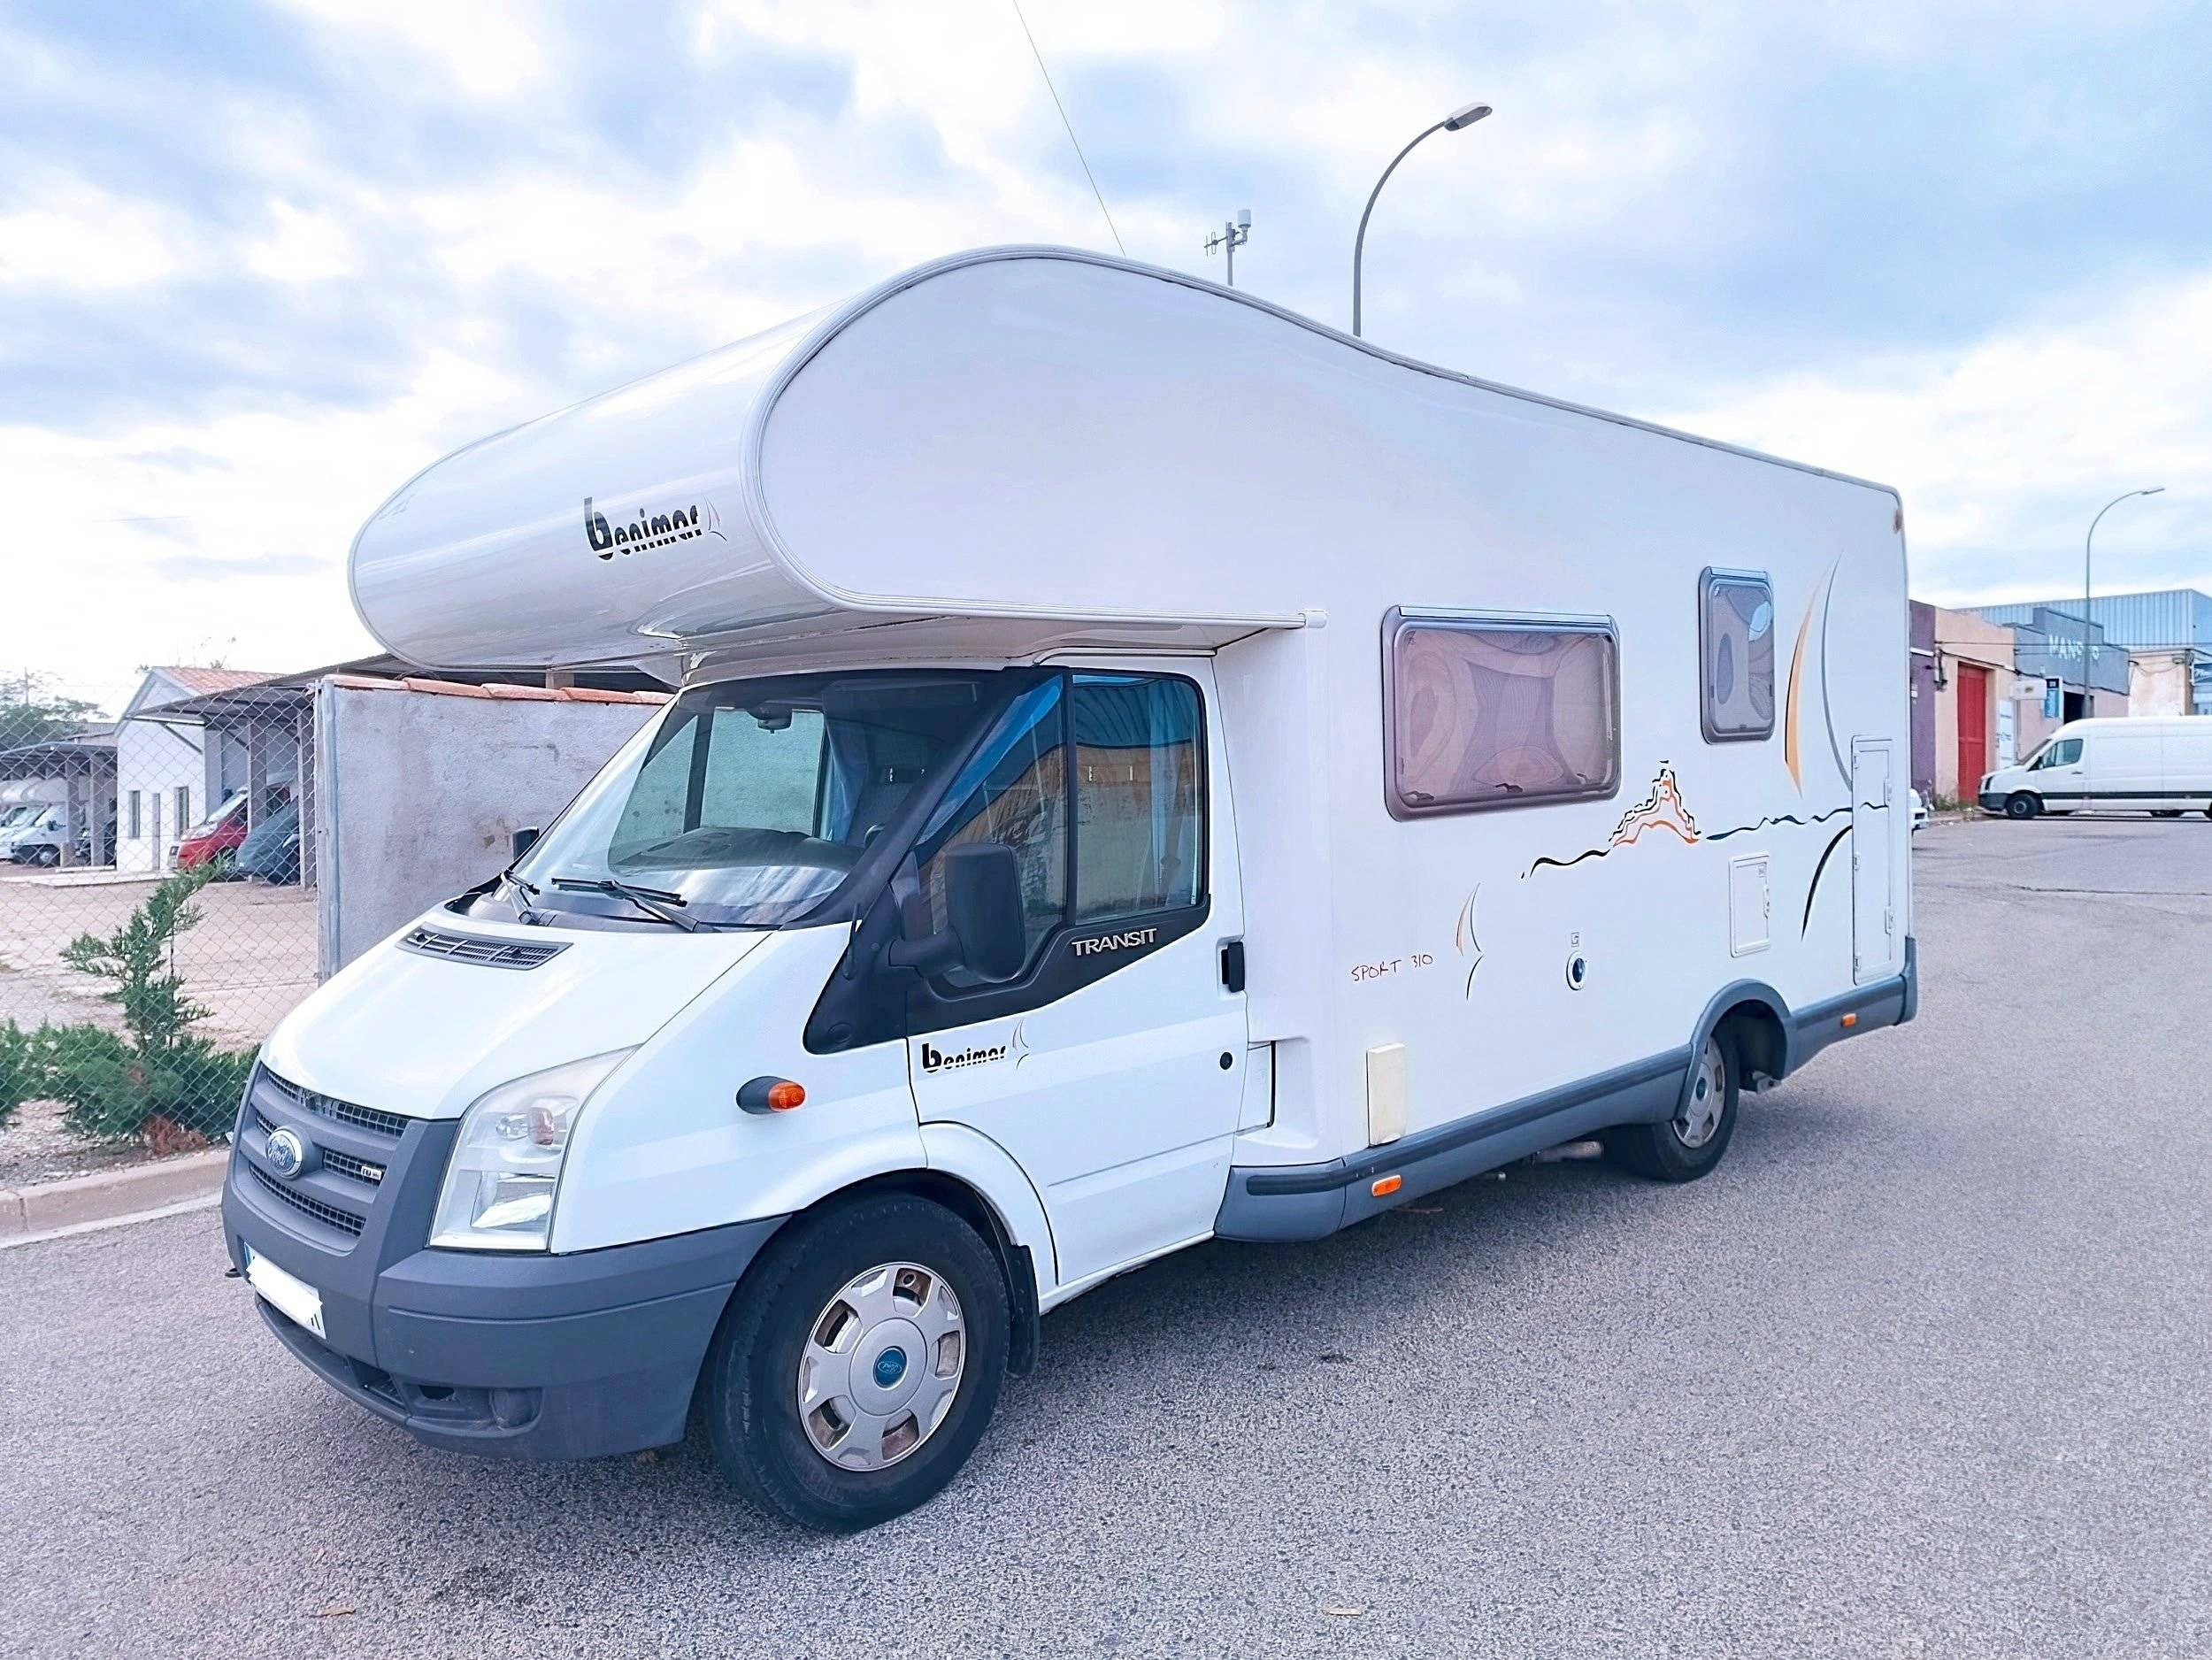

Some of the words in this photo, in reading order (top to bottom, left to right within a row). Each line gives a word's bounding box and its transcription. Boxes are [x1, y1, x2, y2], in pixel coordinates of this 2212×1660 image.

[1071, 928, 1157, 957] TRANSIT
[1351, 959, 1402, 981] SPORT
[1410, 954, 1433, 968] 310
